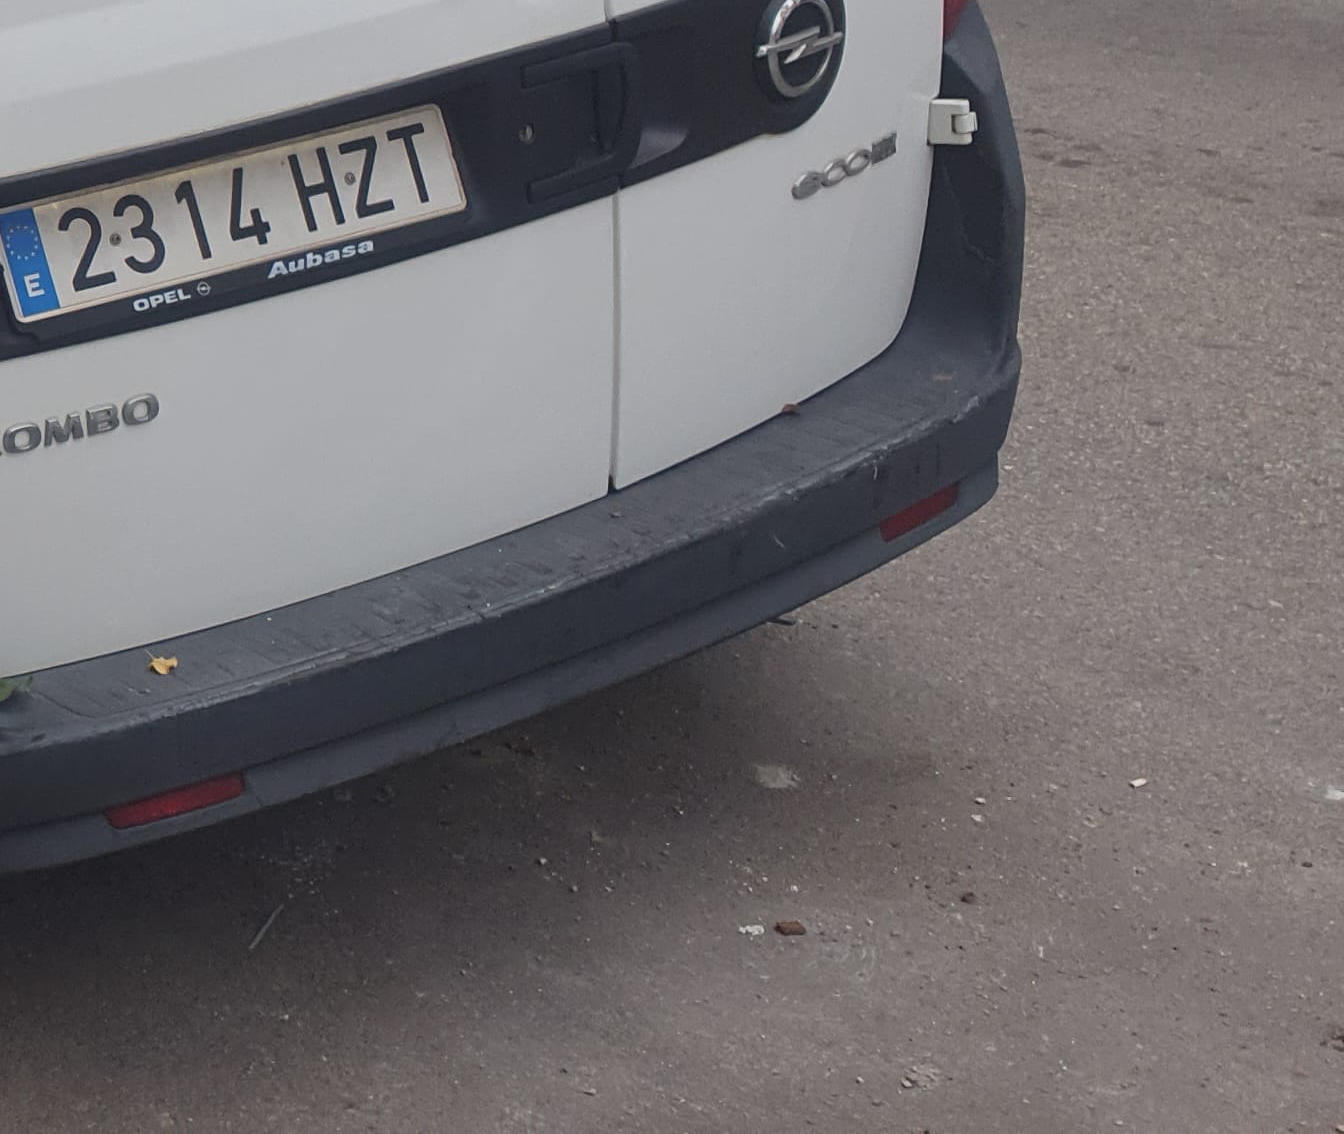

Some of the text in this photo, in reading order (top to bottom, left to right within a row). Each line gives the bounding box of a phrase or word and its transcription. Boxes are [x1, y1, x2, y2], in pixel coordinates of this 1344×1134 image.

[58, 123, 430, 292] 2314 HZT
[23, 273, 45, 298] E
[132, 239, 375, 313] OPEL Aubasa
